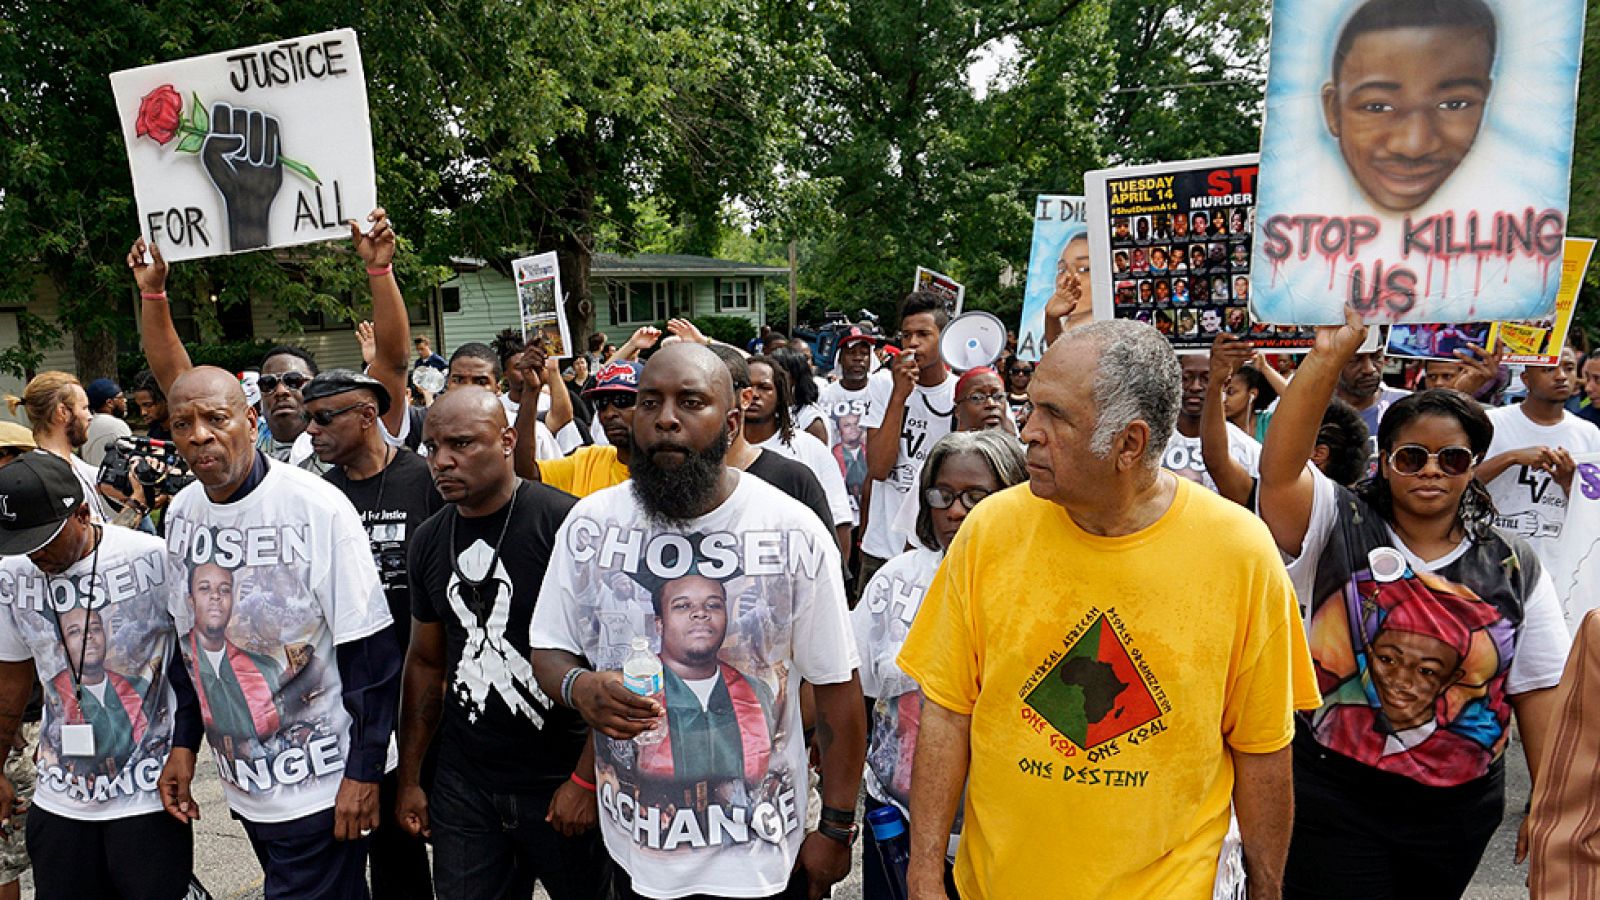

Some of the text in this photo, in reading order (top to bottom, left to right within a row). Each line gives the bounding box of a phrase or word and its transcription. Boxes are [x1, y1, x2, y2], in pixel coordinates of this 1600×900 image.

[227, 40, 347, 92] JUSTICE
[1109, 176, 1174, 193] TUESDAY
[1111, 189, 1174, 205] APRIL 14
[1190, 193, 1252, 209] MURDER
[146, 181, 351, 247] FOR ALL
[1037, 200, 1052, 221] I
[1111, 202, 1177, 215] #ShutDownA14
[1263, 207, 1563, 260] STOP KILLING
[1350, 260, 1418, 315] US
[166, 516, 311, 568] HOSEN
[567, 516, 824, 580] CHOSEN
[0, 551, 164, 612] CHOSEN
[1062, 606, 1100, 649] AFRICAN
[1021, 708, 1077, 757] ONE GOD
[1087, 719, 1168, 763] ONE GOAL
[37, 757, 168, 803] 4CHANG
[1018, 758, 1149, 787] ONE DESTINY
[600, 783, 798, 851] 4CHANGE
